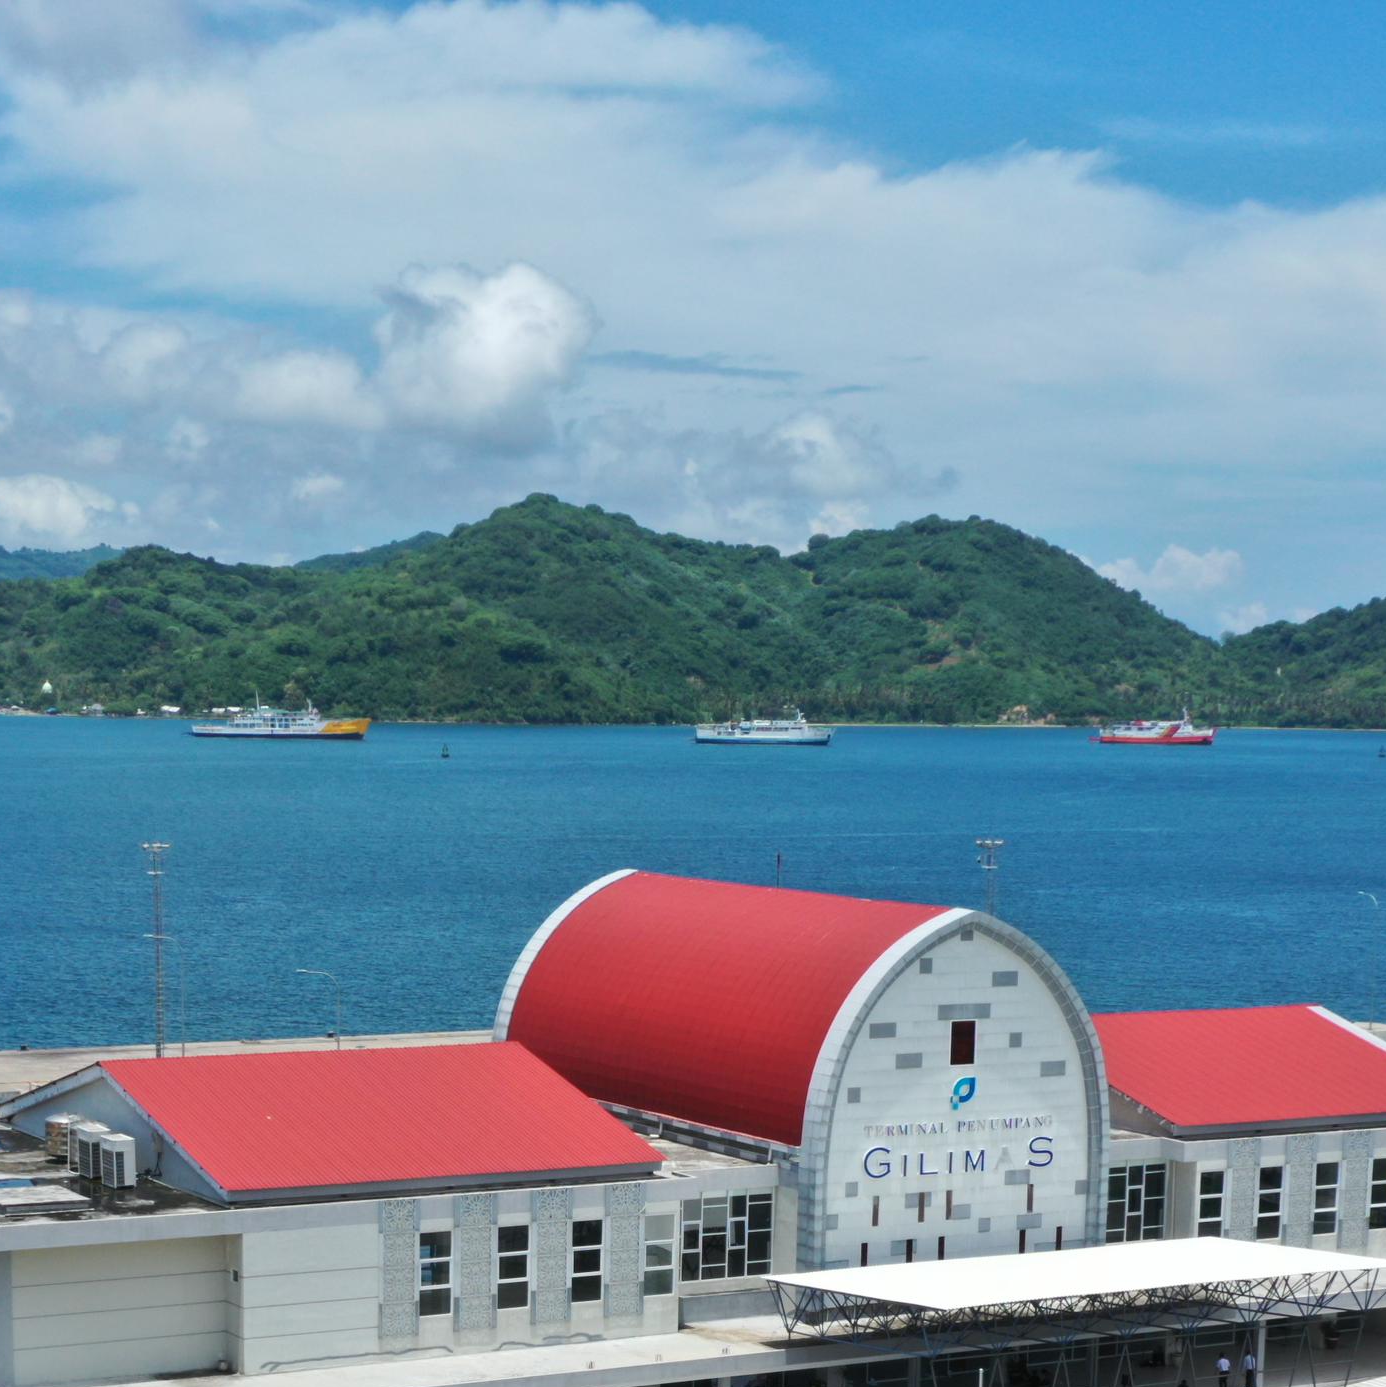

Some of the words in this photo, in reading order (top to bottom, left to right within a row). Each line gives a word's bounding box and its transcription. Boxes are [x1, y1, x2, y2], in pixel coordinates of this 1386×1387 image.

[864, 1121, 948, 1138] TERMINAL
[957, 1115, 1053, 1133] PENUMPANG
[863, 1136, 1054, 1179] GILIMAS
